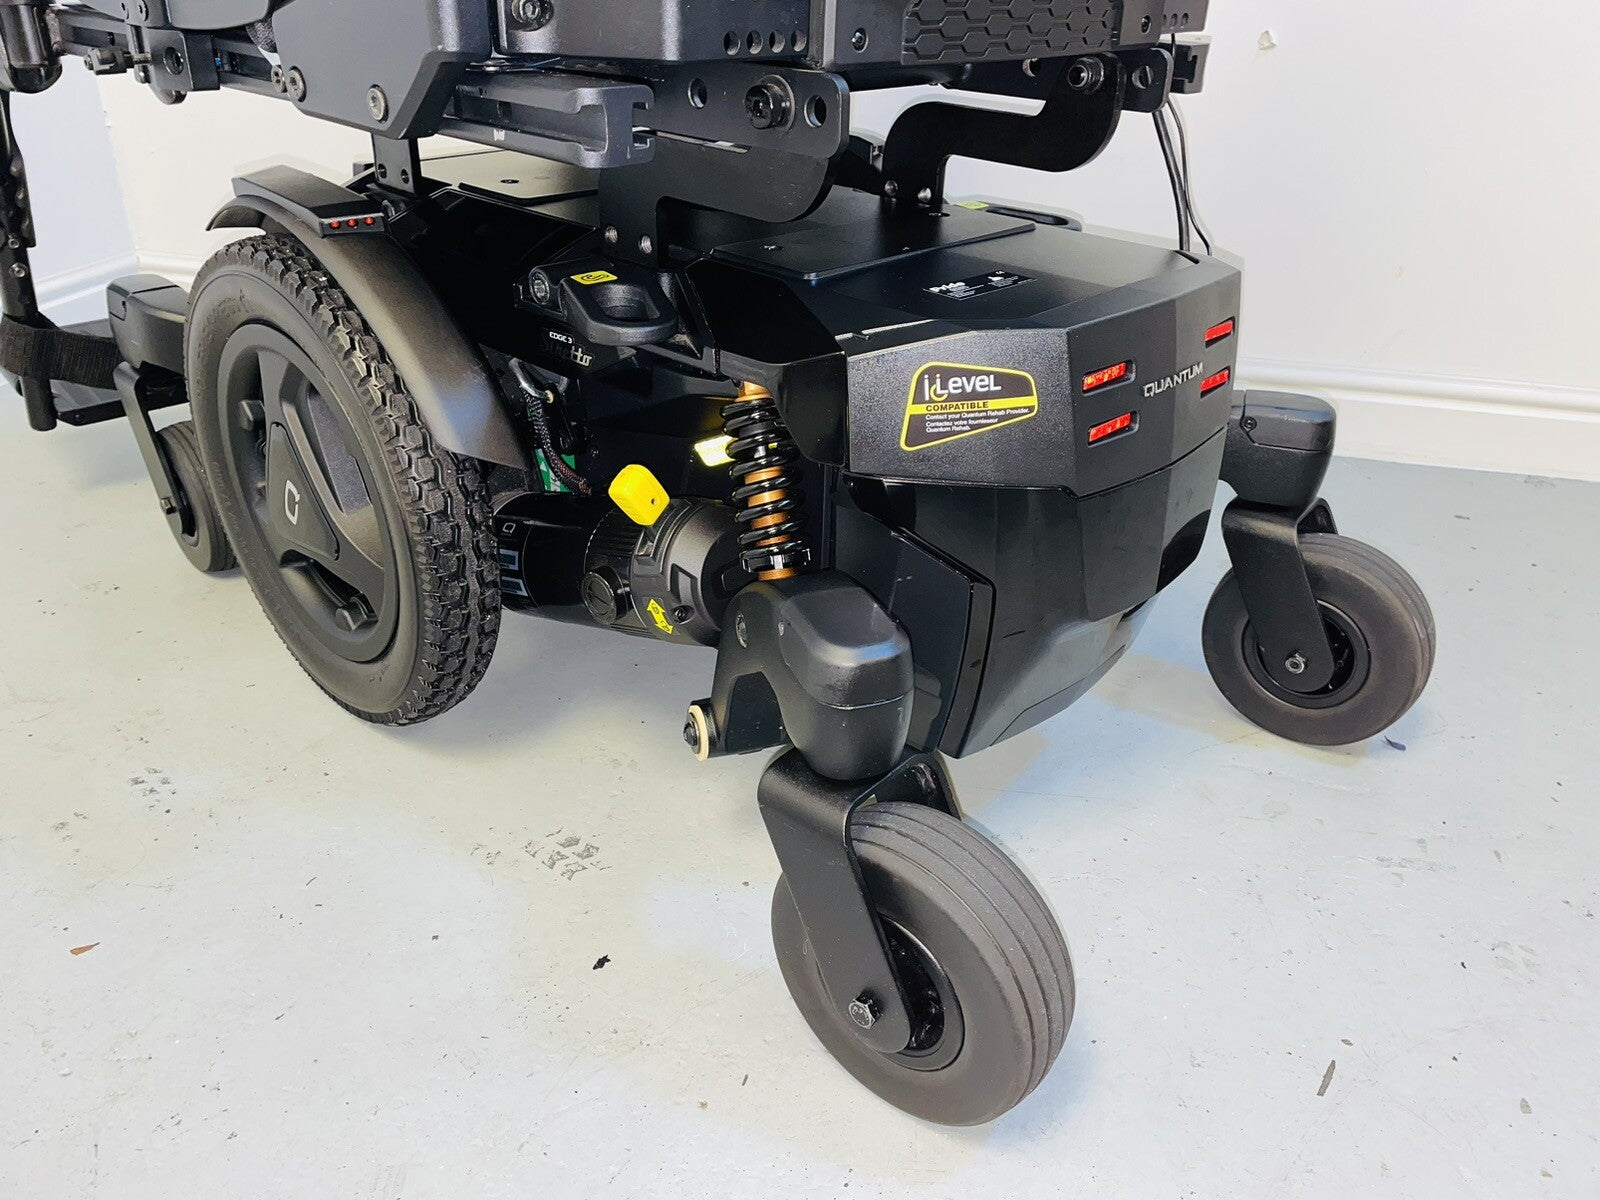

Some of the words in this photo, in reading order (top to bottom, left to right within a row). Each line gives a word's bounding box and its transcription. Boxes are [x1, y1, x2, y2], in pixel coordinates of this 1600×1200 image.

[549, 331, 568, 343] EDGE
[1143, 361, 1203, 397] QUANTUM
[925, 401, 989, 412] COMPATIBLE
[961, 411, 987, 419] Quantum
